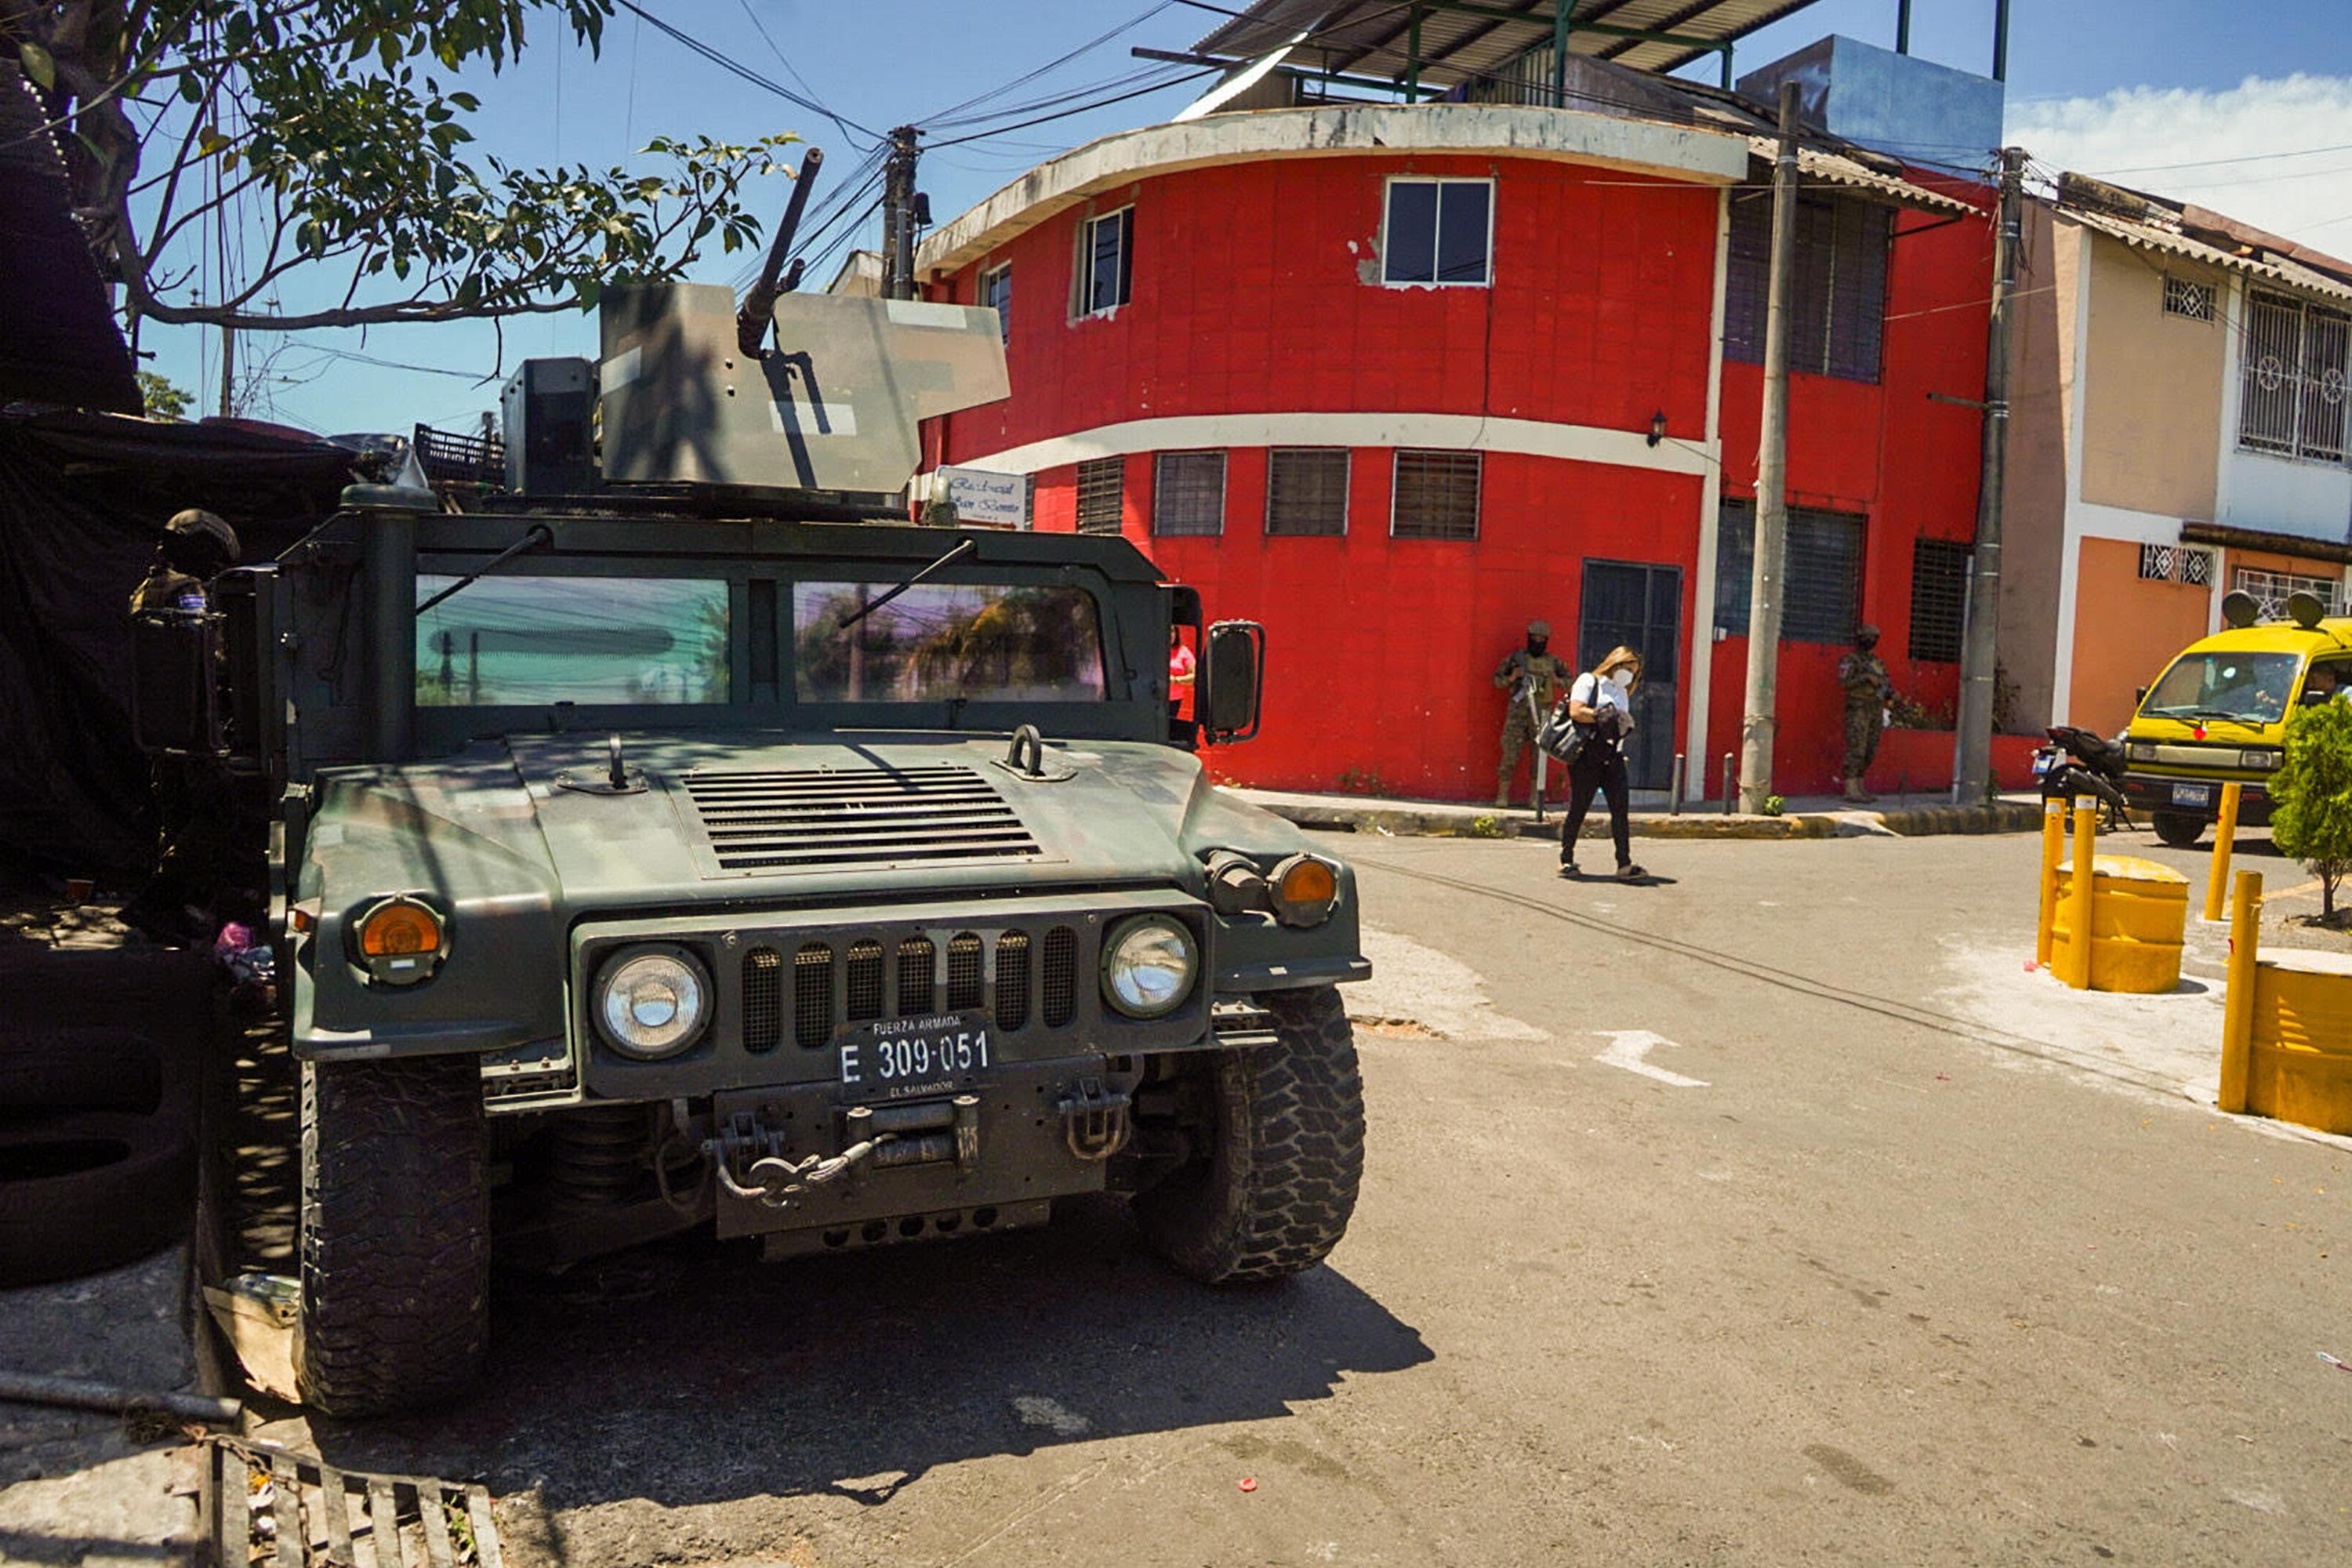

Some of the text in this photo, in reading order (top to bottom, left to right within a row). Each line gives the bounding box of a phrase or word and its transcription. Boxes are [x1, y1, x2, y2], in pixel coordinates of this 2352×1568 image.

[873, 1015, 961, 1036] FUERZA ARMADA
[840, 1044, 861, 1083] E
[890, 1080, 954, 1098] EL SALVADOR
